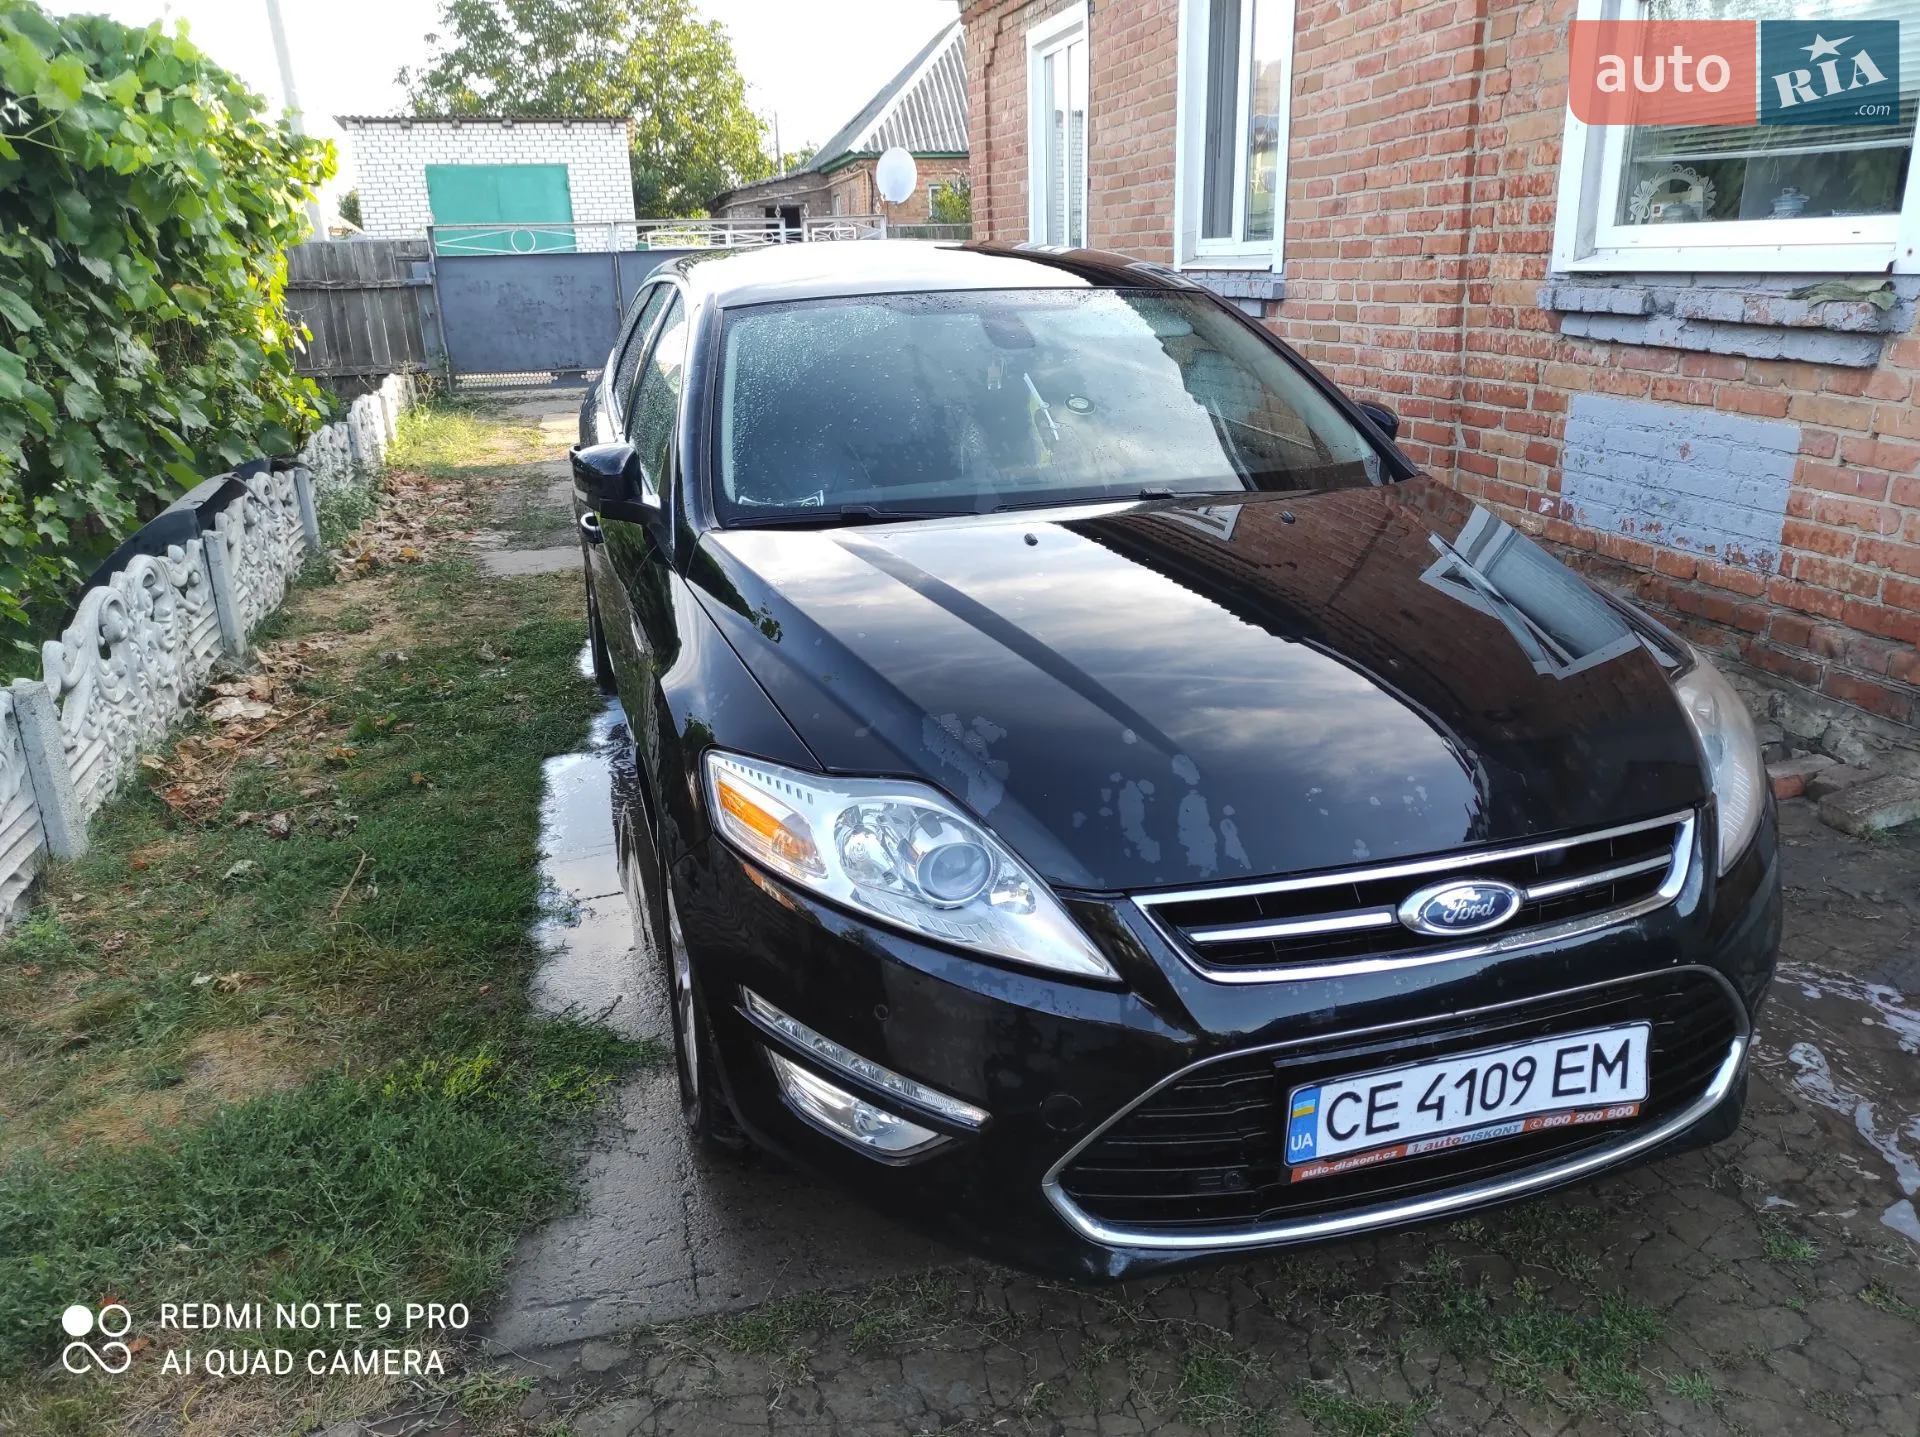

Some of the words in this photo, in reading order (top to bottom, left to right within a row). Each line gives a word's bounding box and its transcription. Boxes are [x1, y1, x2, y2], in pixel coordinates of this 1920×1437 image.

[1443, 896, 1495, 923] Ford
[1326, 1080, 1403, 1141] CE
[1416, 1055, 1538, 1121] 4109
[1551, 1038, 1632, 1098] EM
[1290, 1132, 1314, 1152] UA
[1301, 1149, 1398, 1178] auto-diskont.cz
[1543, 1115, 1572, 1128] 800
[1575, 1111, 1604, 1124] 200
[1607, 1105, 1634, 1119] 800
